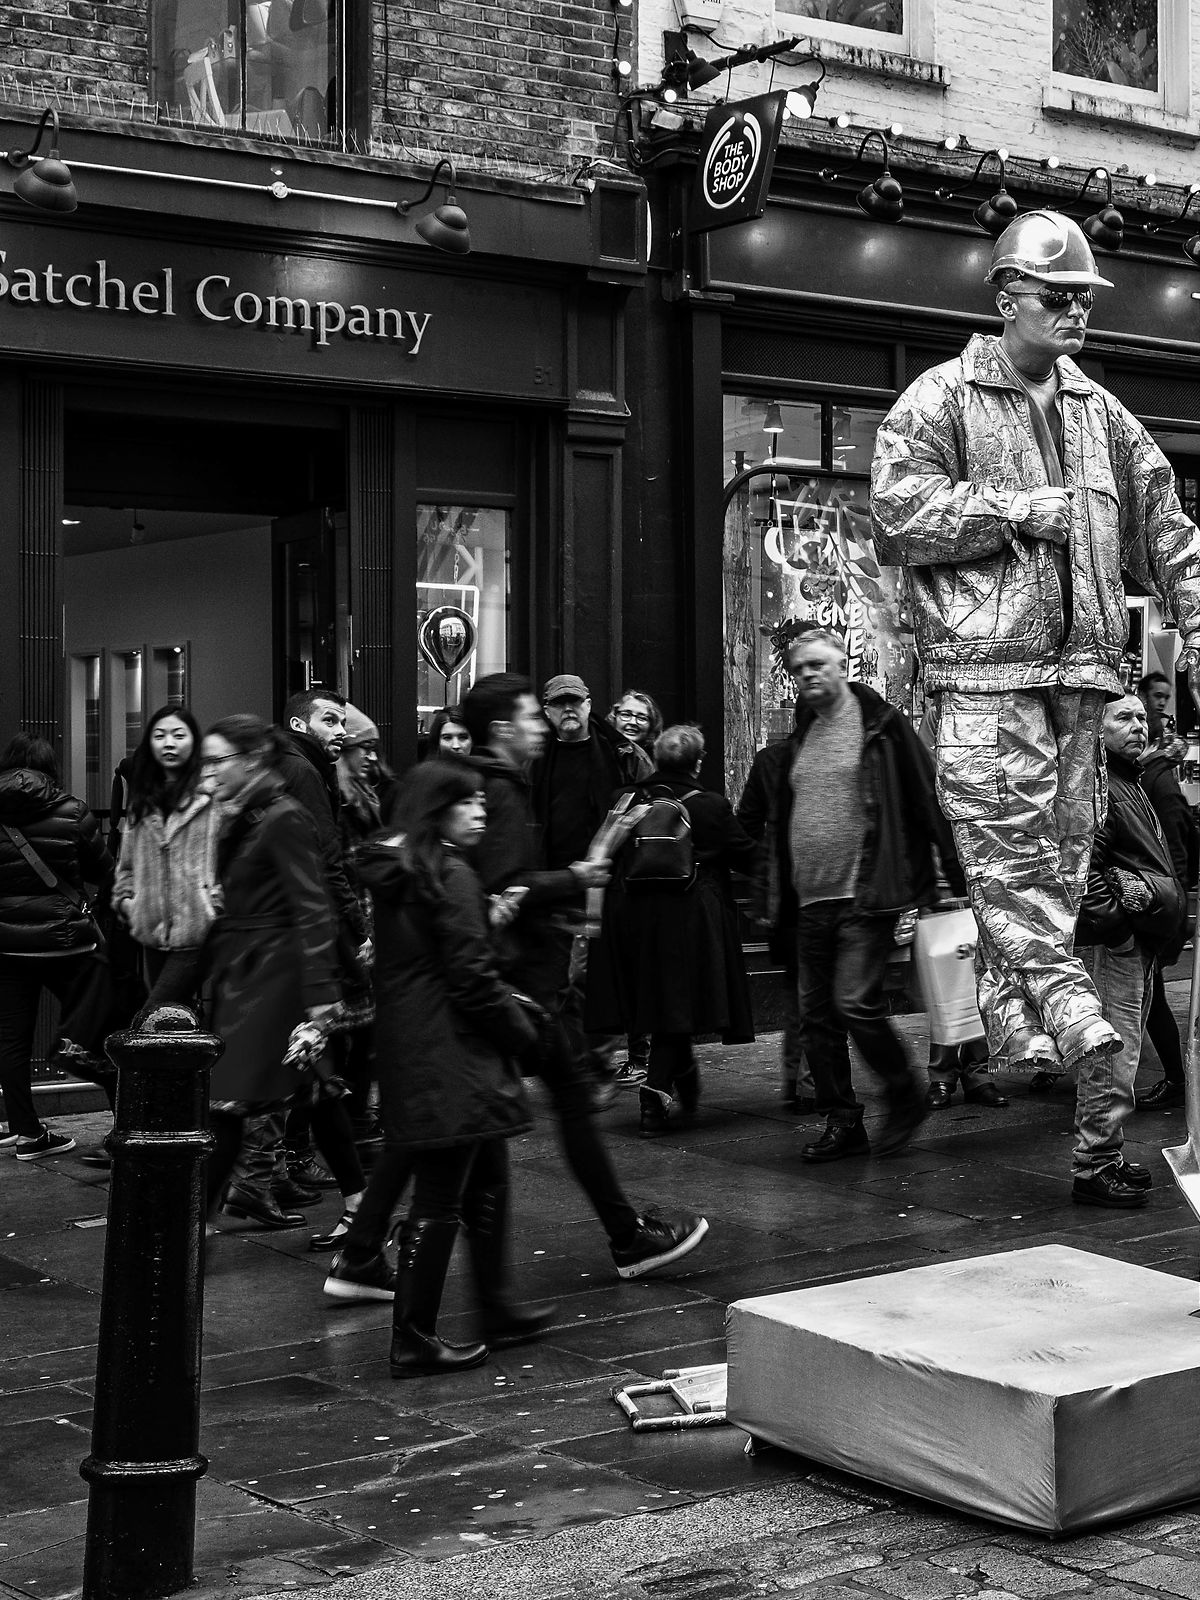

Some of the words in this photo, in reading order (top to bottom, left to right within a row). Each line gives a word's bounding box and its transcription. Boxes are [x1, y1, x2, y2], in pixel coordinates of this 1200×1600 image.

[724, 140, 745, 159] THE
[713, 153, 750, 177] BODY
[711, 171, 744, 194] SHOP
[195, 274, 432, 355] Company
